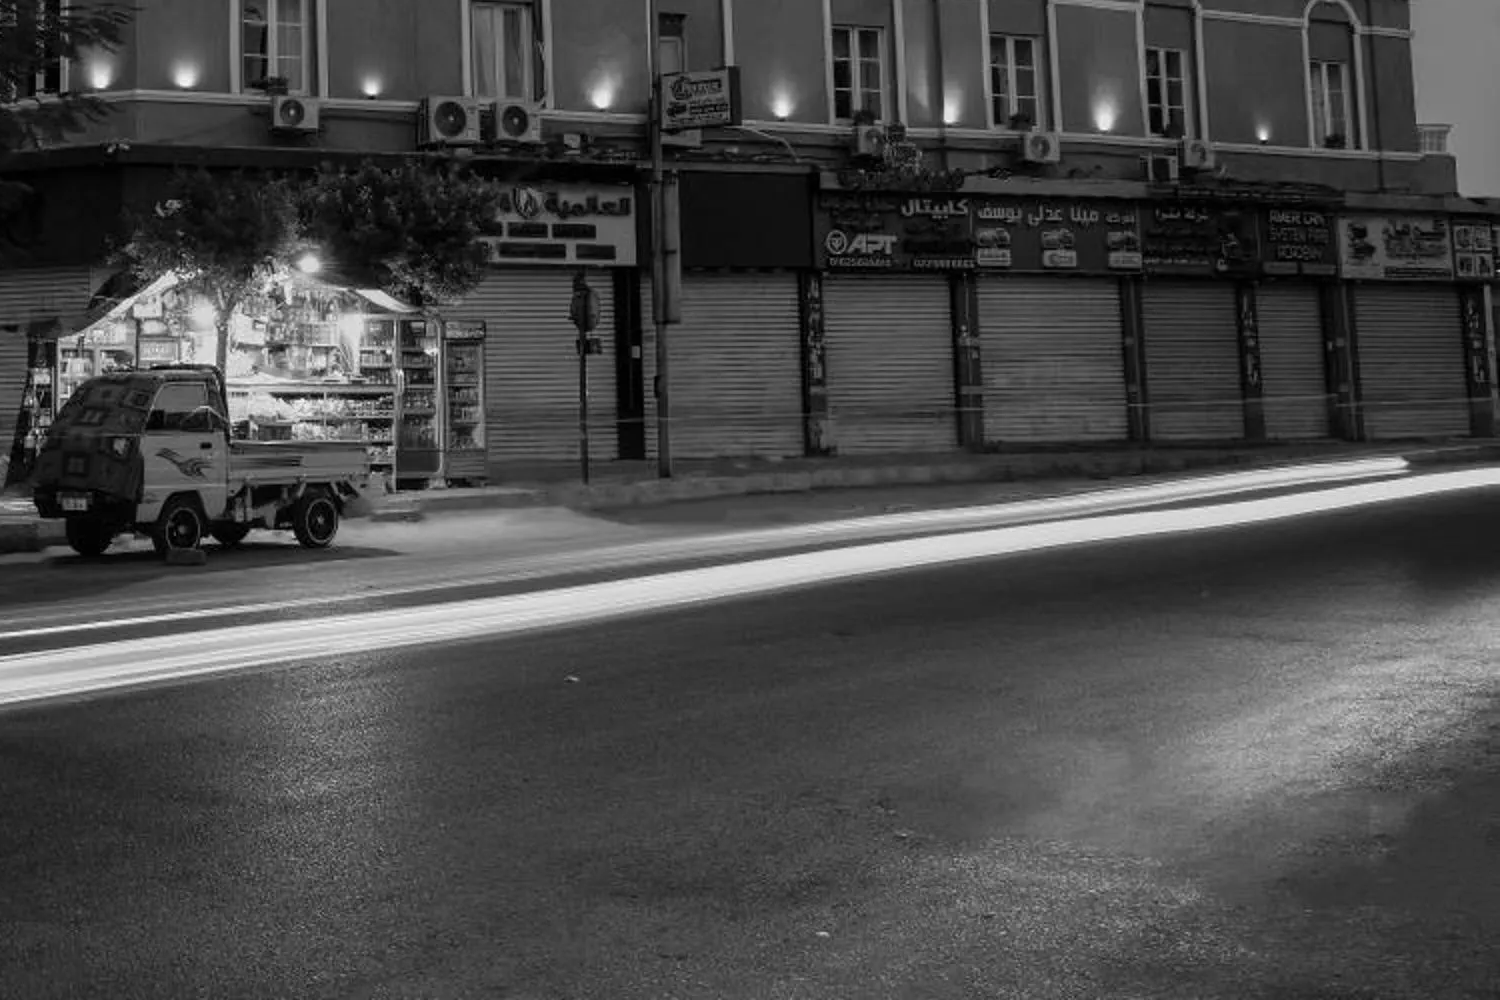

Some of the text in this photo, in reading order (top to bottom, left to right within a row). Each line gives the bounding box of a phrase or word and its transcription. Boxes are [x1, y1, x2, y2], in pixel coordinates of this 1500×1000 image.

[900, 197, 969, 219] كابيتال
[977, 202, 1022, 223] يوسف
[846, 232, 898, 255] APT
